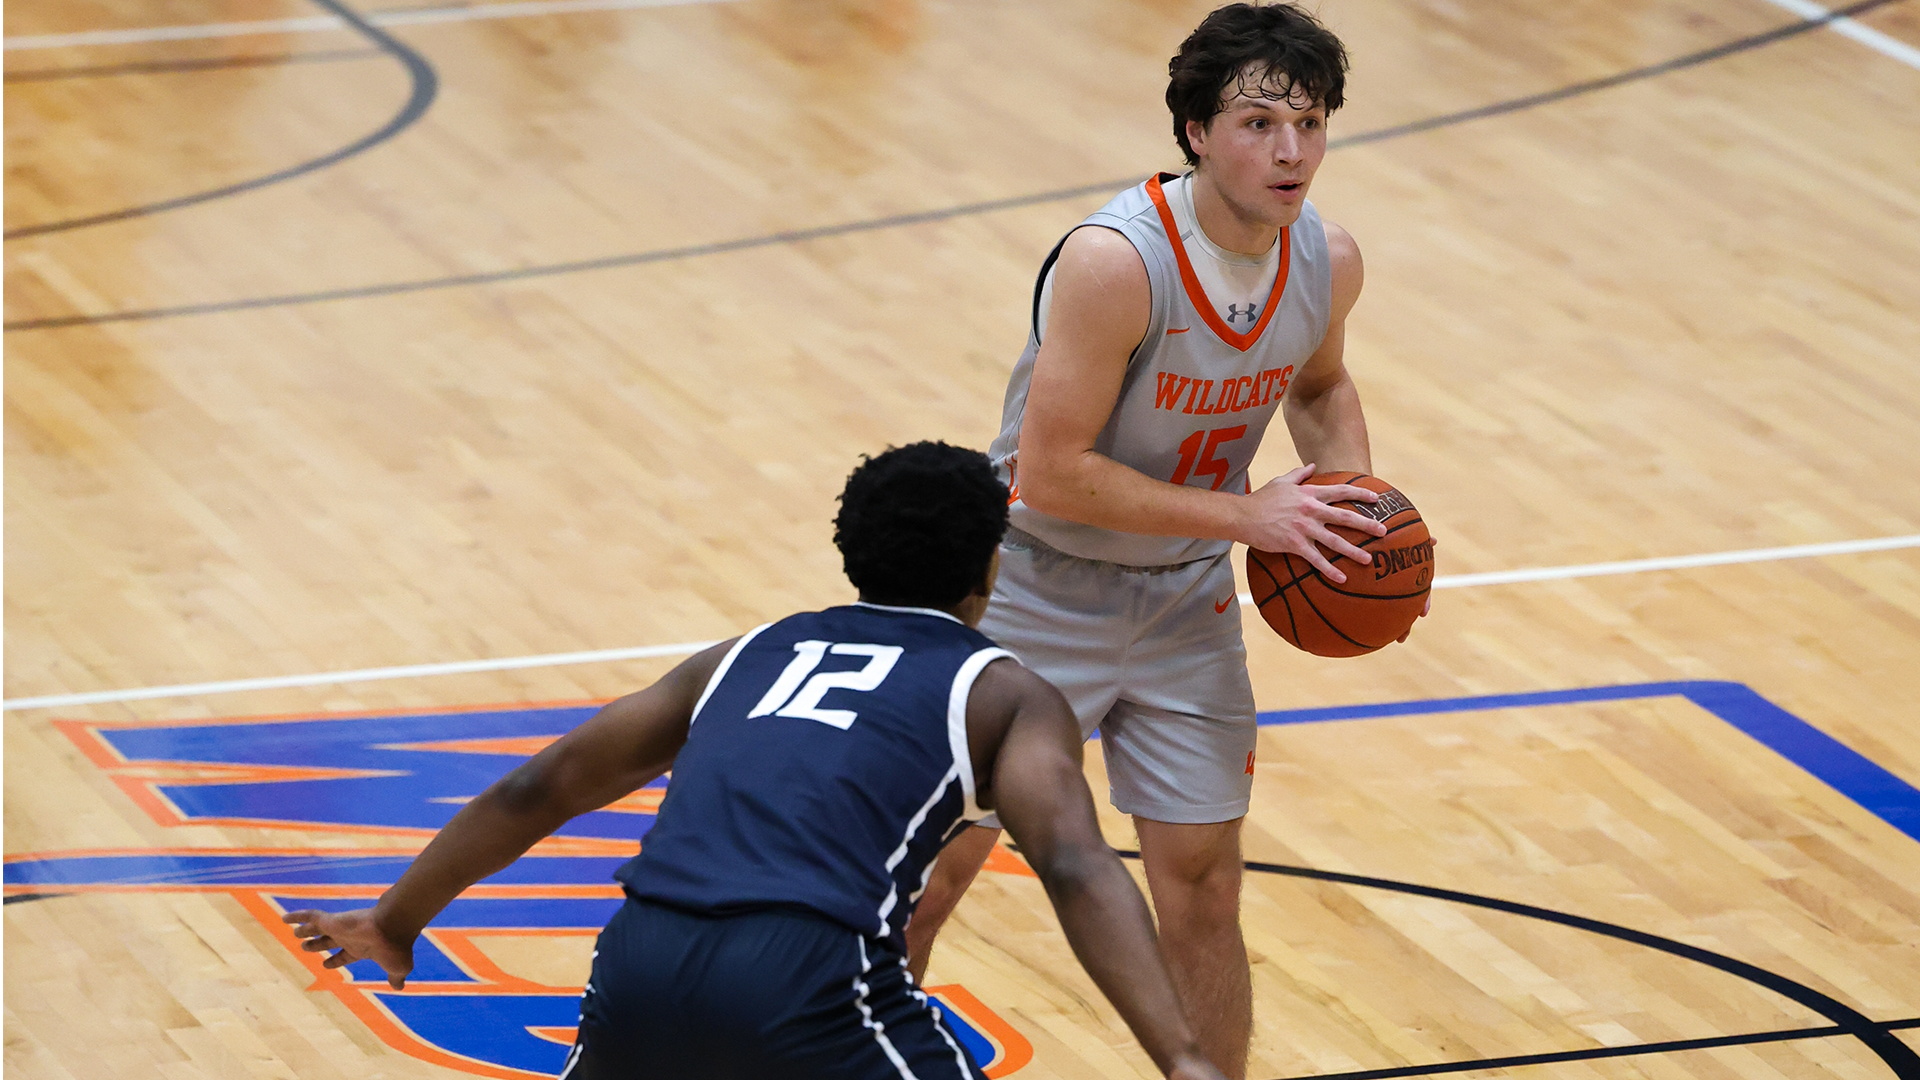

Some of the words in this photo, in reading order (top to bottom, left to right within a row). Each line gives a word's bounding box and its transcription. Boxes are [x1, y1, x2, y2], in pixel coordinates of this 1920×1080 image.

[1155, 364, 1294, 415] WILDCATS
[1170, 424, 1247, 491] 15
[1372, 538, 1433, 581] ALDING
[747, 640, 904, 730] 12
